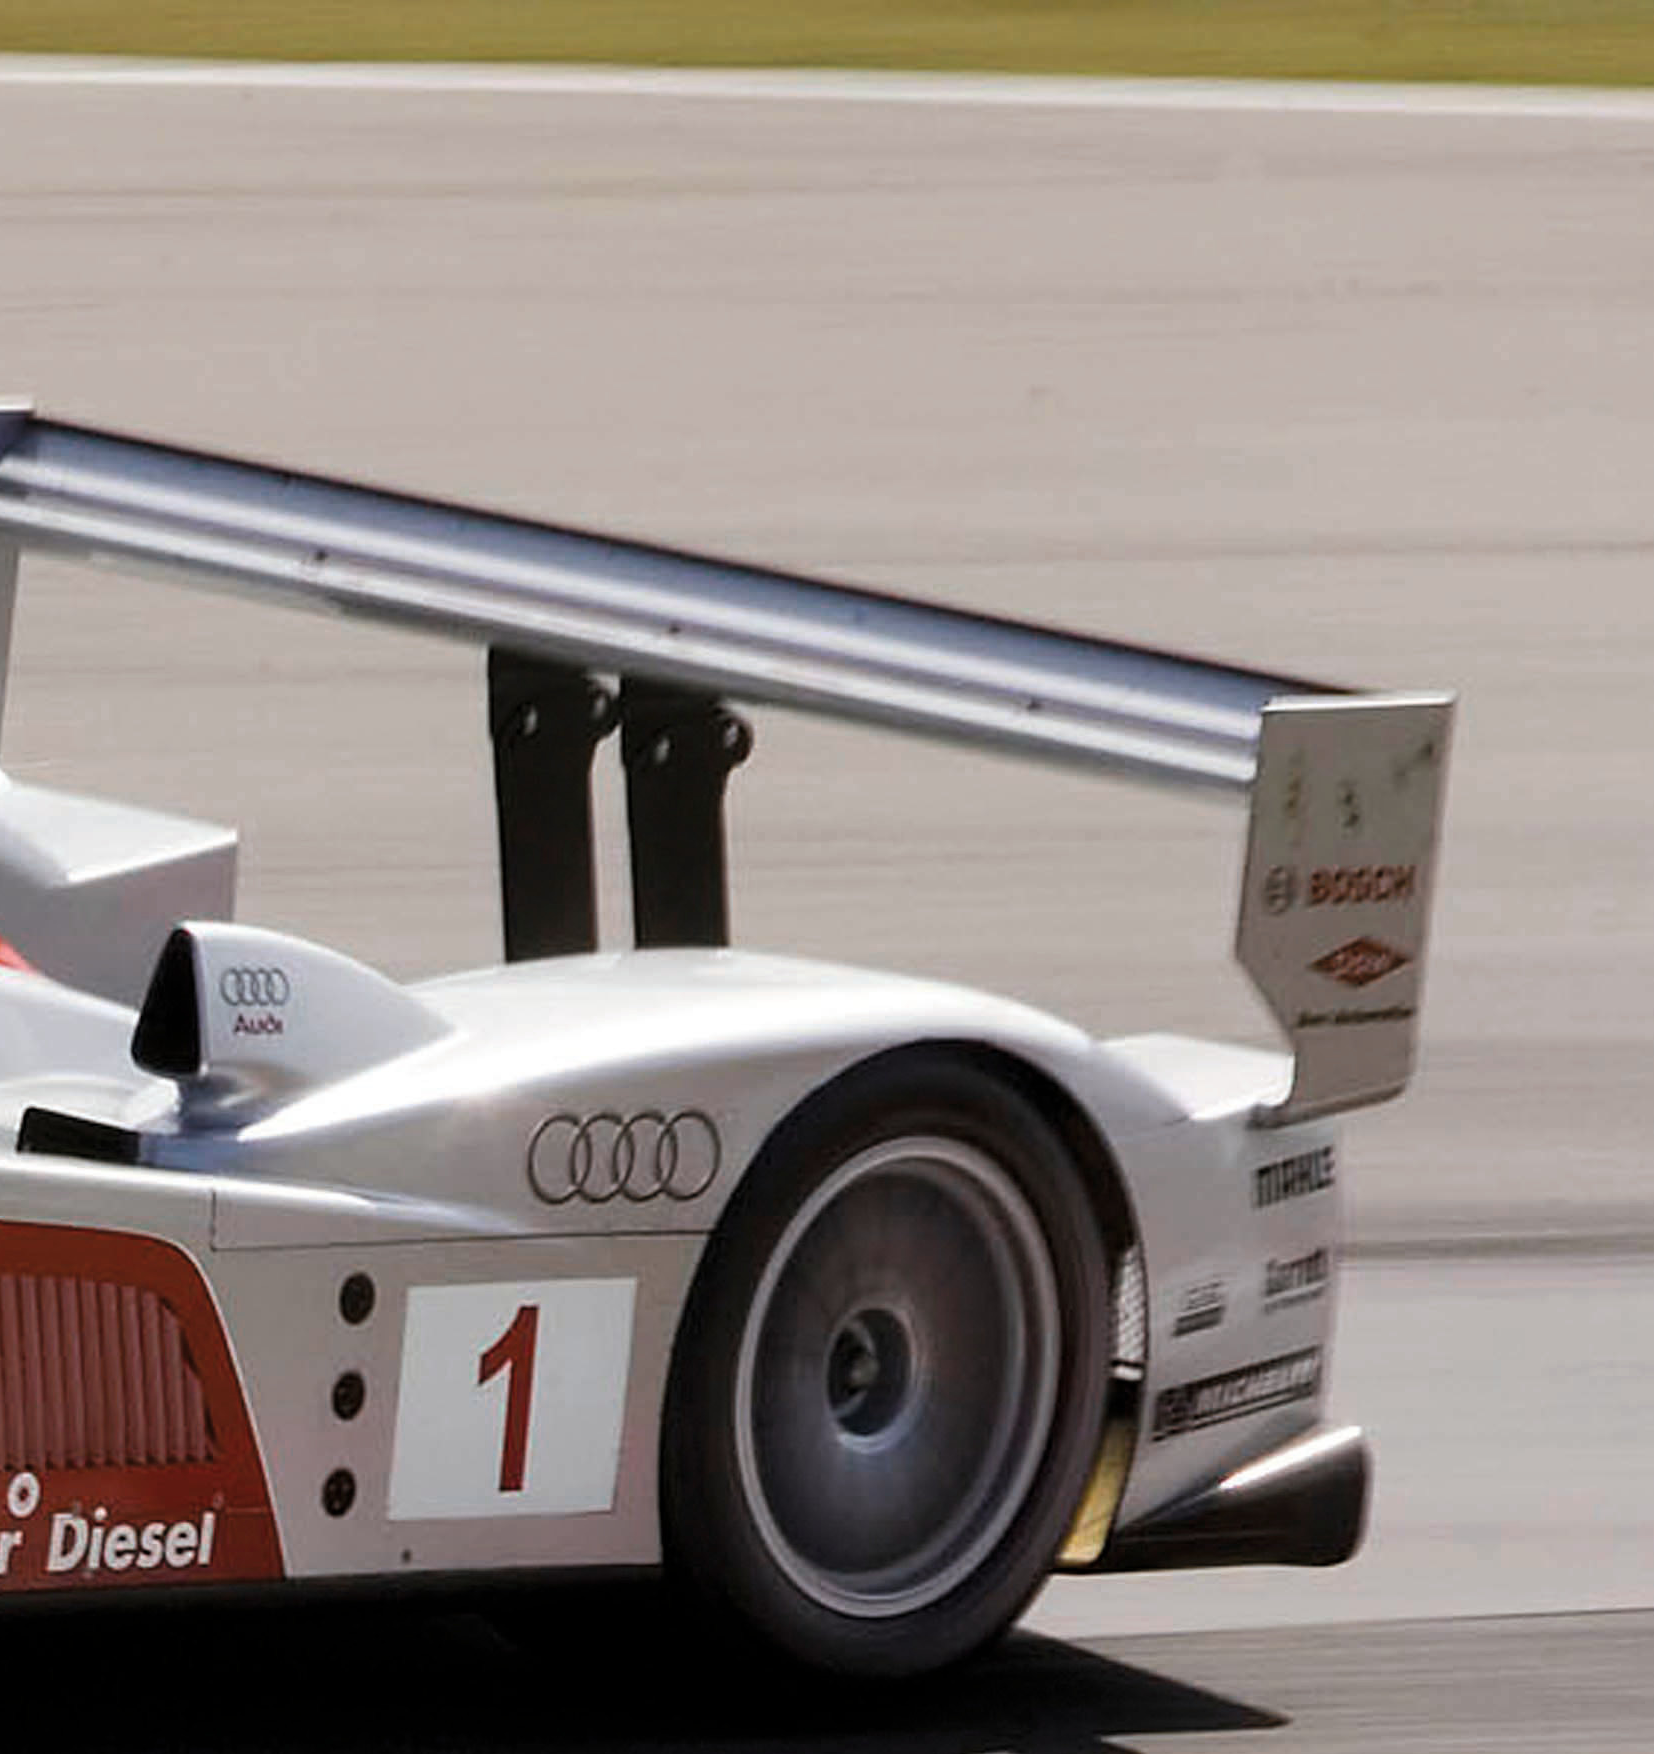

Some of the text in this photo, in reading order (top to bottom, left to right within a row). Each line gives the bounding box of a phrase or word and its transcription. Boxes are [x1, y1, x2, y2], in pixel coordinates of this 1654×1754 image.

[1305, 863, 1417, 908] BOSCH
[233, 1012, 285, 1036] Audi
[478, 1303, 541, 1493] 1
[46, 1506, 216, 1576] Diesel
